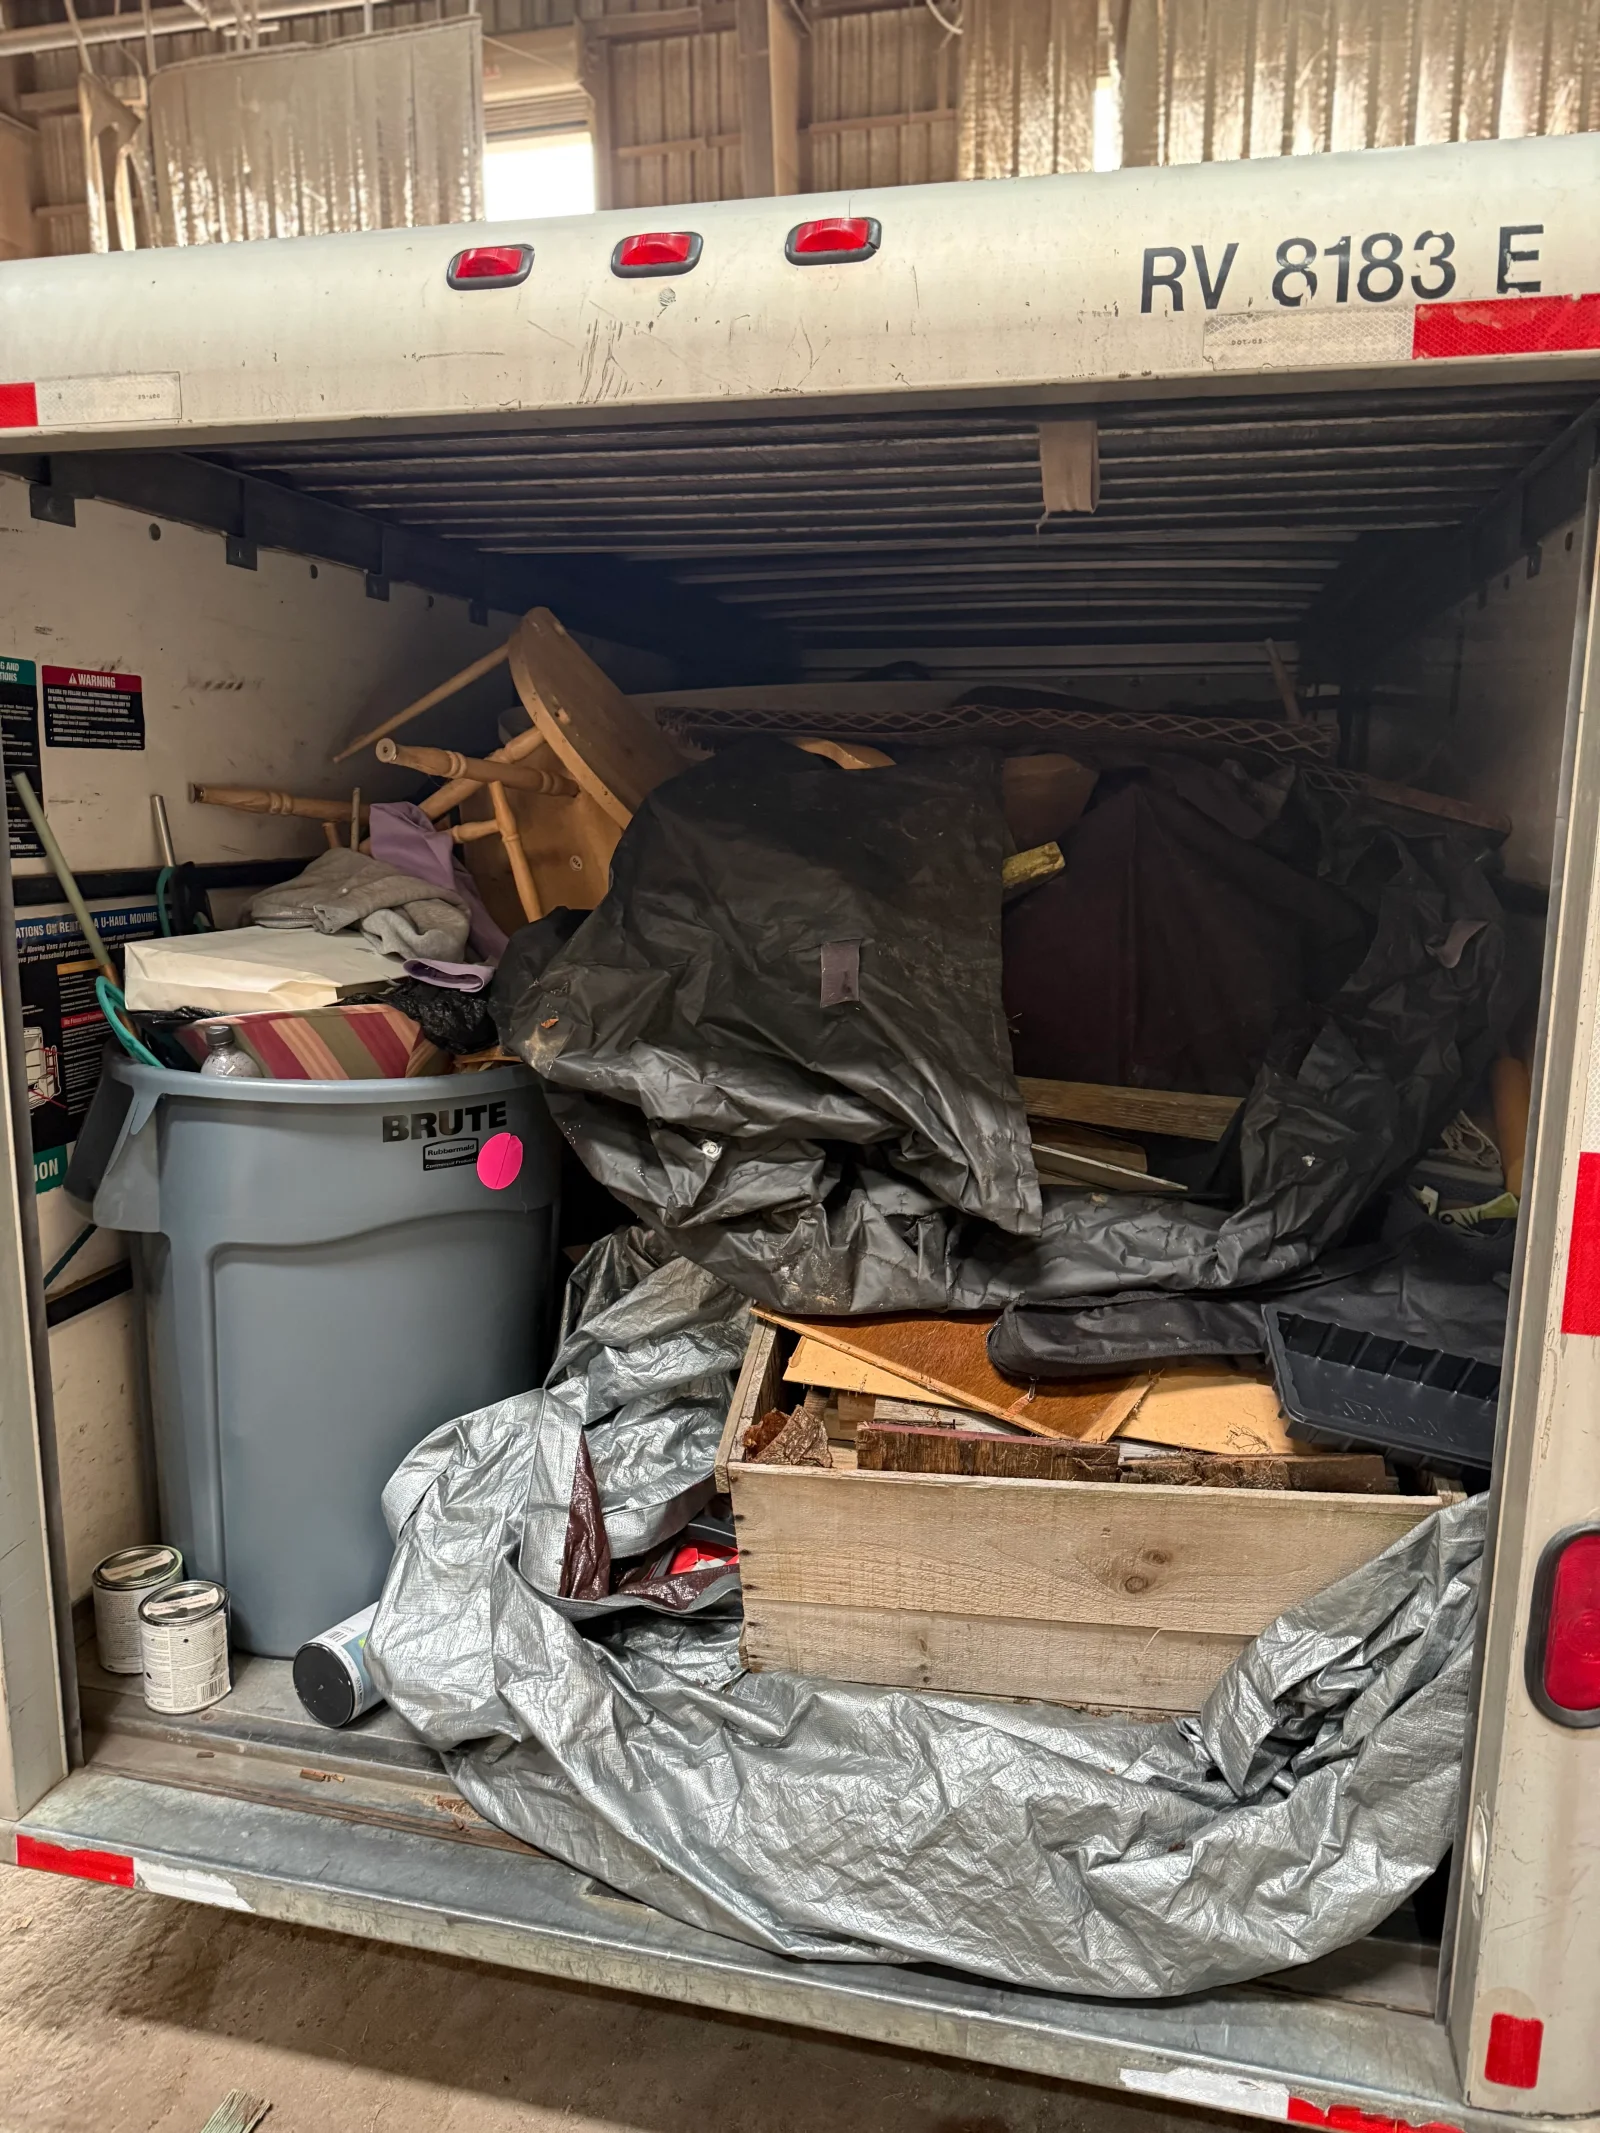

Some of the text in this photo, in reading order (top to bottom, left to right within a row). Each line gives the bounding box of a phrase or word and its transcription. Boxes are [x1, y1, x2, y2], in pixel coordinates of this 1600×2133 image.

[1141, 224, 1545, 314] RV 8183 E
[6, 662, 20, 672] AND
[78, 673, 116, 688] WARNING
[94, 918, 99, 928] A
[101, 914, 128, 928] U-HAUL
[130, 912, 157, 924] MOVING
[382, 1101, 507, 1143] BRUTE
[428, 1144, 474, 1156] Rubbermaid
[33, 1157, 59, 1182] ION
